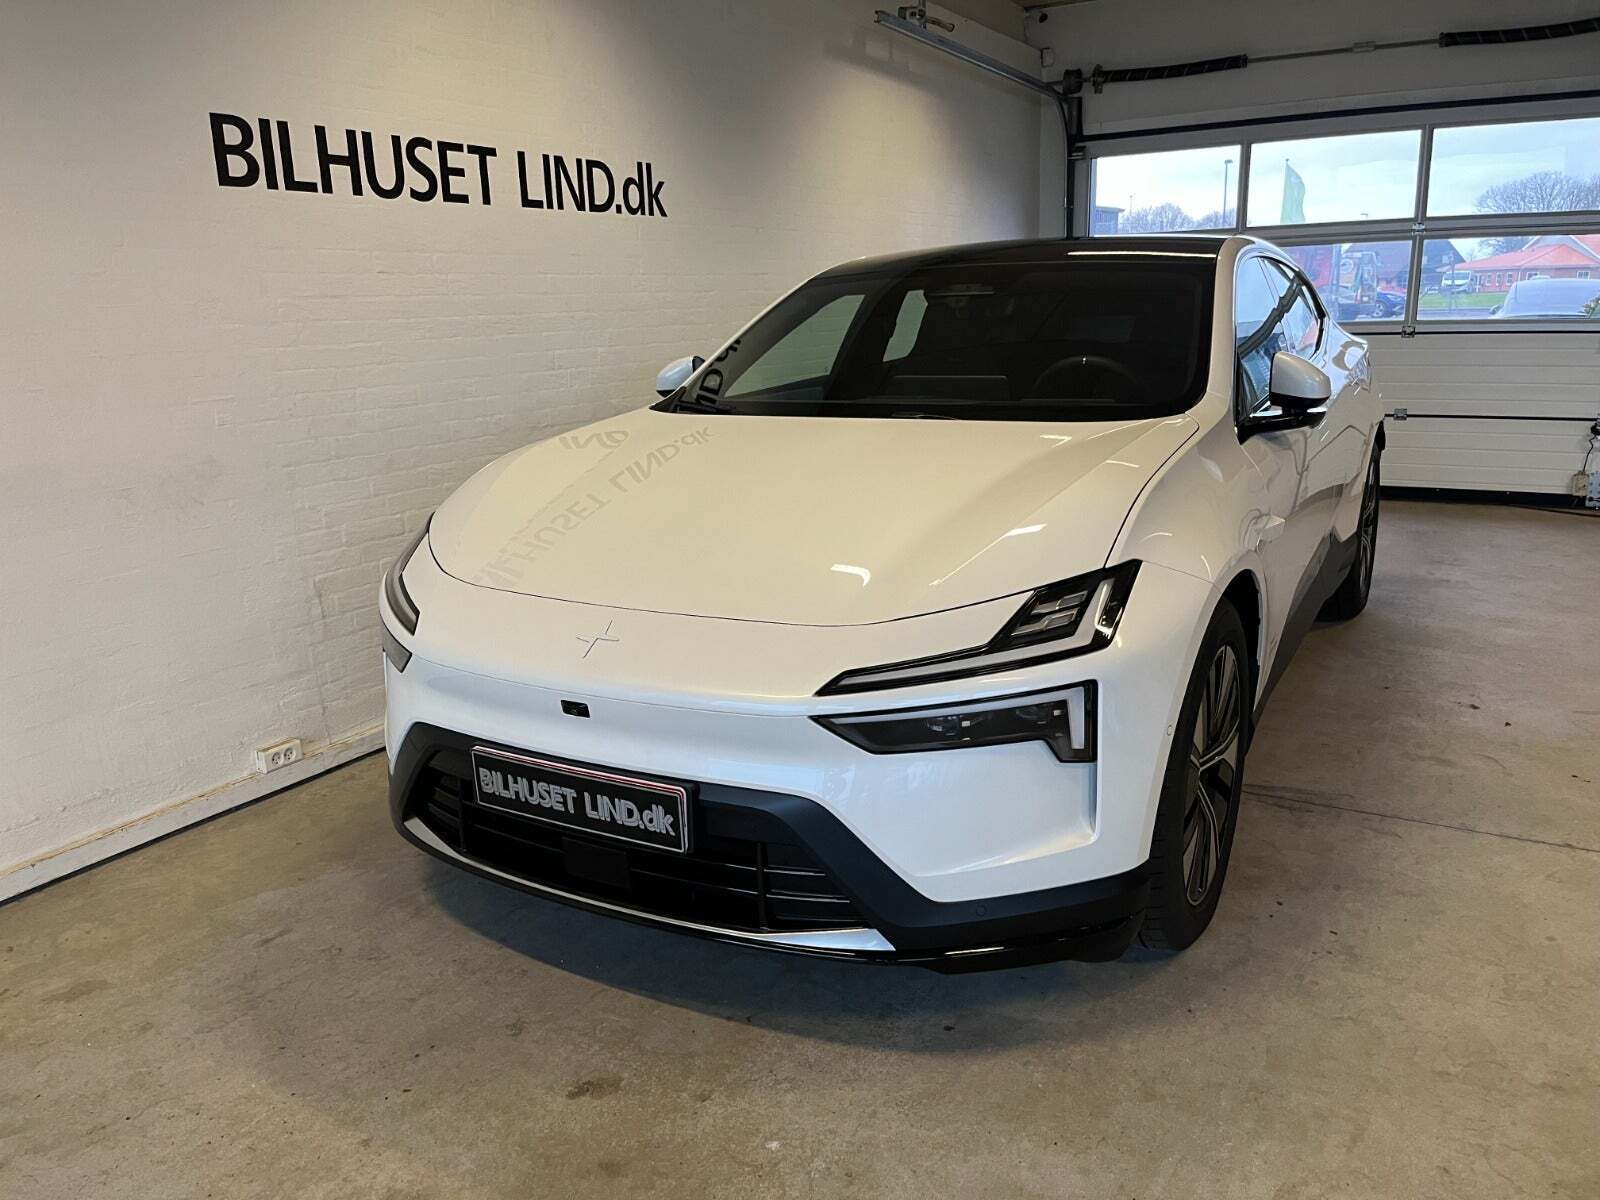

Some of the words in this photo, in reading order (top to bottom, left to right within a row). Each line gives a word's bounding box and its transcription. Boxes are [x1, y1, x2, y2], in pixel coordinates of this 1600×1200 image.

[209, 112, 497, 206] BILHUSET
[517, 150, 668, 218] LIND.dk
[478, 767, 577, 814] BILHUSET
[584, 791, 676, 836] LIND.dk
